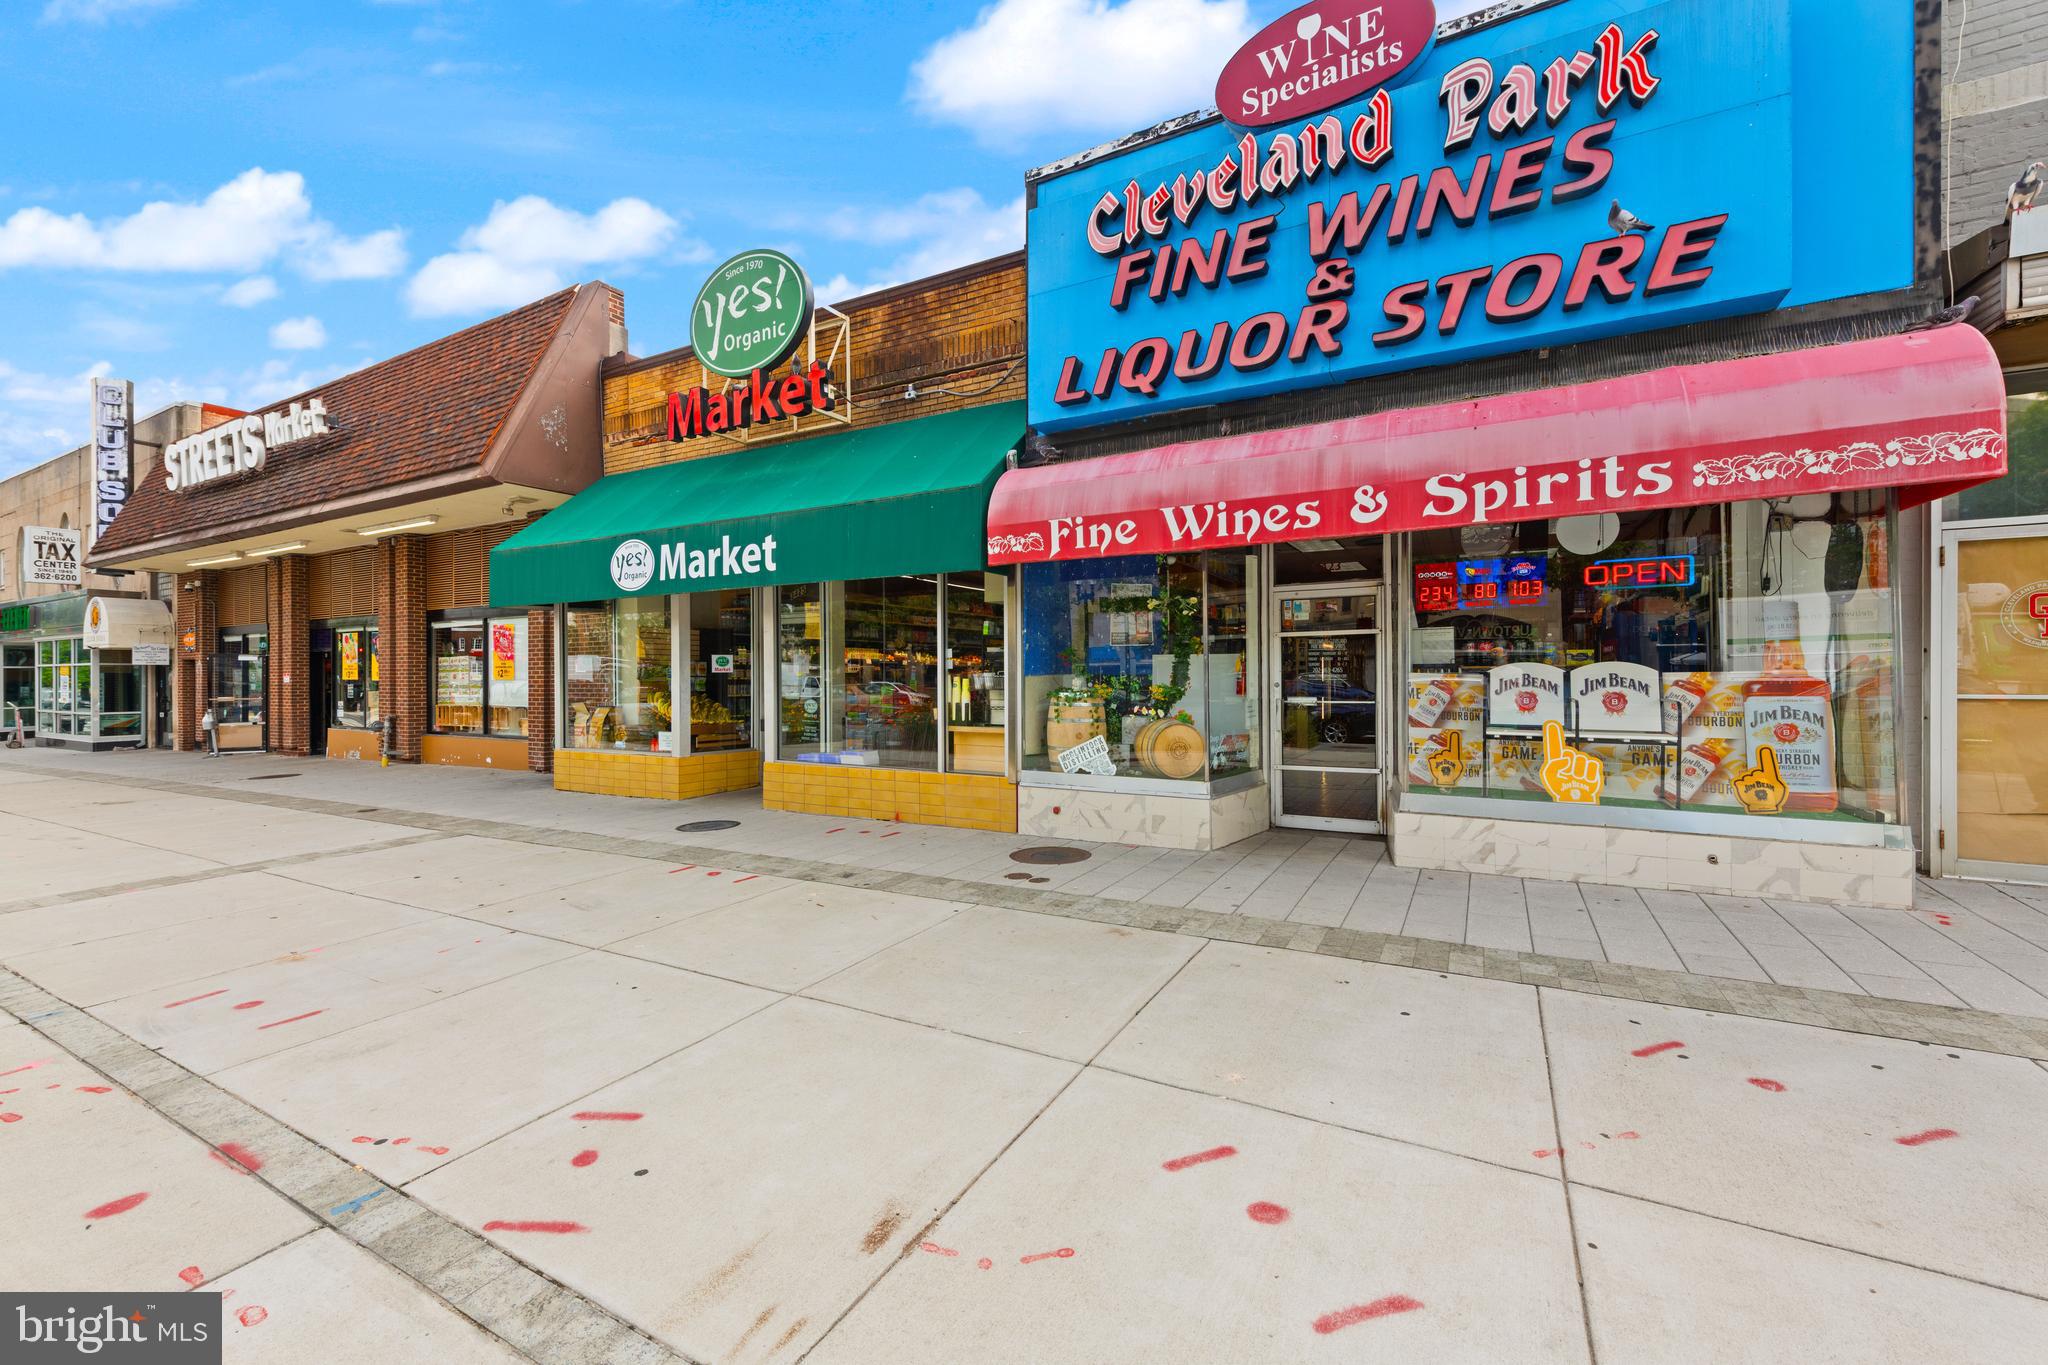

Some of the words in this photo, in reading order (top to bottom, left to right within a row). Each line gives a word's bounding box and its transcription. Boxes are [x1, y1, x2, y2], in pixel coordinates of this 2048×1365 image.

[1256, 7, 1386, 79] WINE
[1241, 41, 1403, 118] Specialists
[1086, 89, 1393, 256] Cleveland
[1439, 23, 1660, 155] Park
[1110, 214, 1279, 311] FINE
[1306, 119, 1617, 262] WINES
[725, 264, 744, 281] Since
[745, 259, 764, 271] 1970
[1306, 257, 1355, 302] &
[703, 264, 787, 361] yes!
[1053, 300, 1349, 407] LIQUOR
[1372, 213, 1730, 348] STORE
[723, 320, 786, 352] Organic
[667, 359, 834, 442] Market
[164, 414, 266, 493] STREETS
[264, 398, 330, 448] Market
[1048, 517, 1138, 557] Fine
[1160, 500, 1320, 543] Wines
[1350, 485, 1388, 523] &
[1423, 456, 1673, 521] Spirits
[33, 534, 76, 543] ORIGINAL
[33, 540, 77, 562] TAX
[659, 534, 777, 581] Market
[33, 560, 77, 569] CENTER
[34, 572, 77, 581] 362-6200
[616, 548, 648, 582] yes!
[624, 571, 648, 581] Organic
[1584, 559, 1687, 587] OPEN
[1420, 586, 1453, 602] 234
[1474, 583, 1497, 599] 80
[2004, 585, 2036, 612] CLEVELAND
[1495, 677, 1519, 696] JIM
[1522, 673, 1559, 697] BEAM
[1580, 677, 1606, 696] JIM
[1609, 673, 1650, 697] BEAM
[1666, 691, 1680, 699] JIM
[1441, 711, 1481, 721] BOURBON
[1688, 715, 1743, 727] BOURBON
[1751, 709, 1778, 728] JIM
[1780, 705, 1825, 729] BEAM
[1063, 744, 1106, 770] DISTILLING
[1502, 746, 1538, 761] GAME
[1681, 757, 1694, 766] JIM
[1693, 760, 1710, 777] BEAM
[1744, 783, 1756, 794] JIM
[1755, 781, 1775, 792] BEAM
